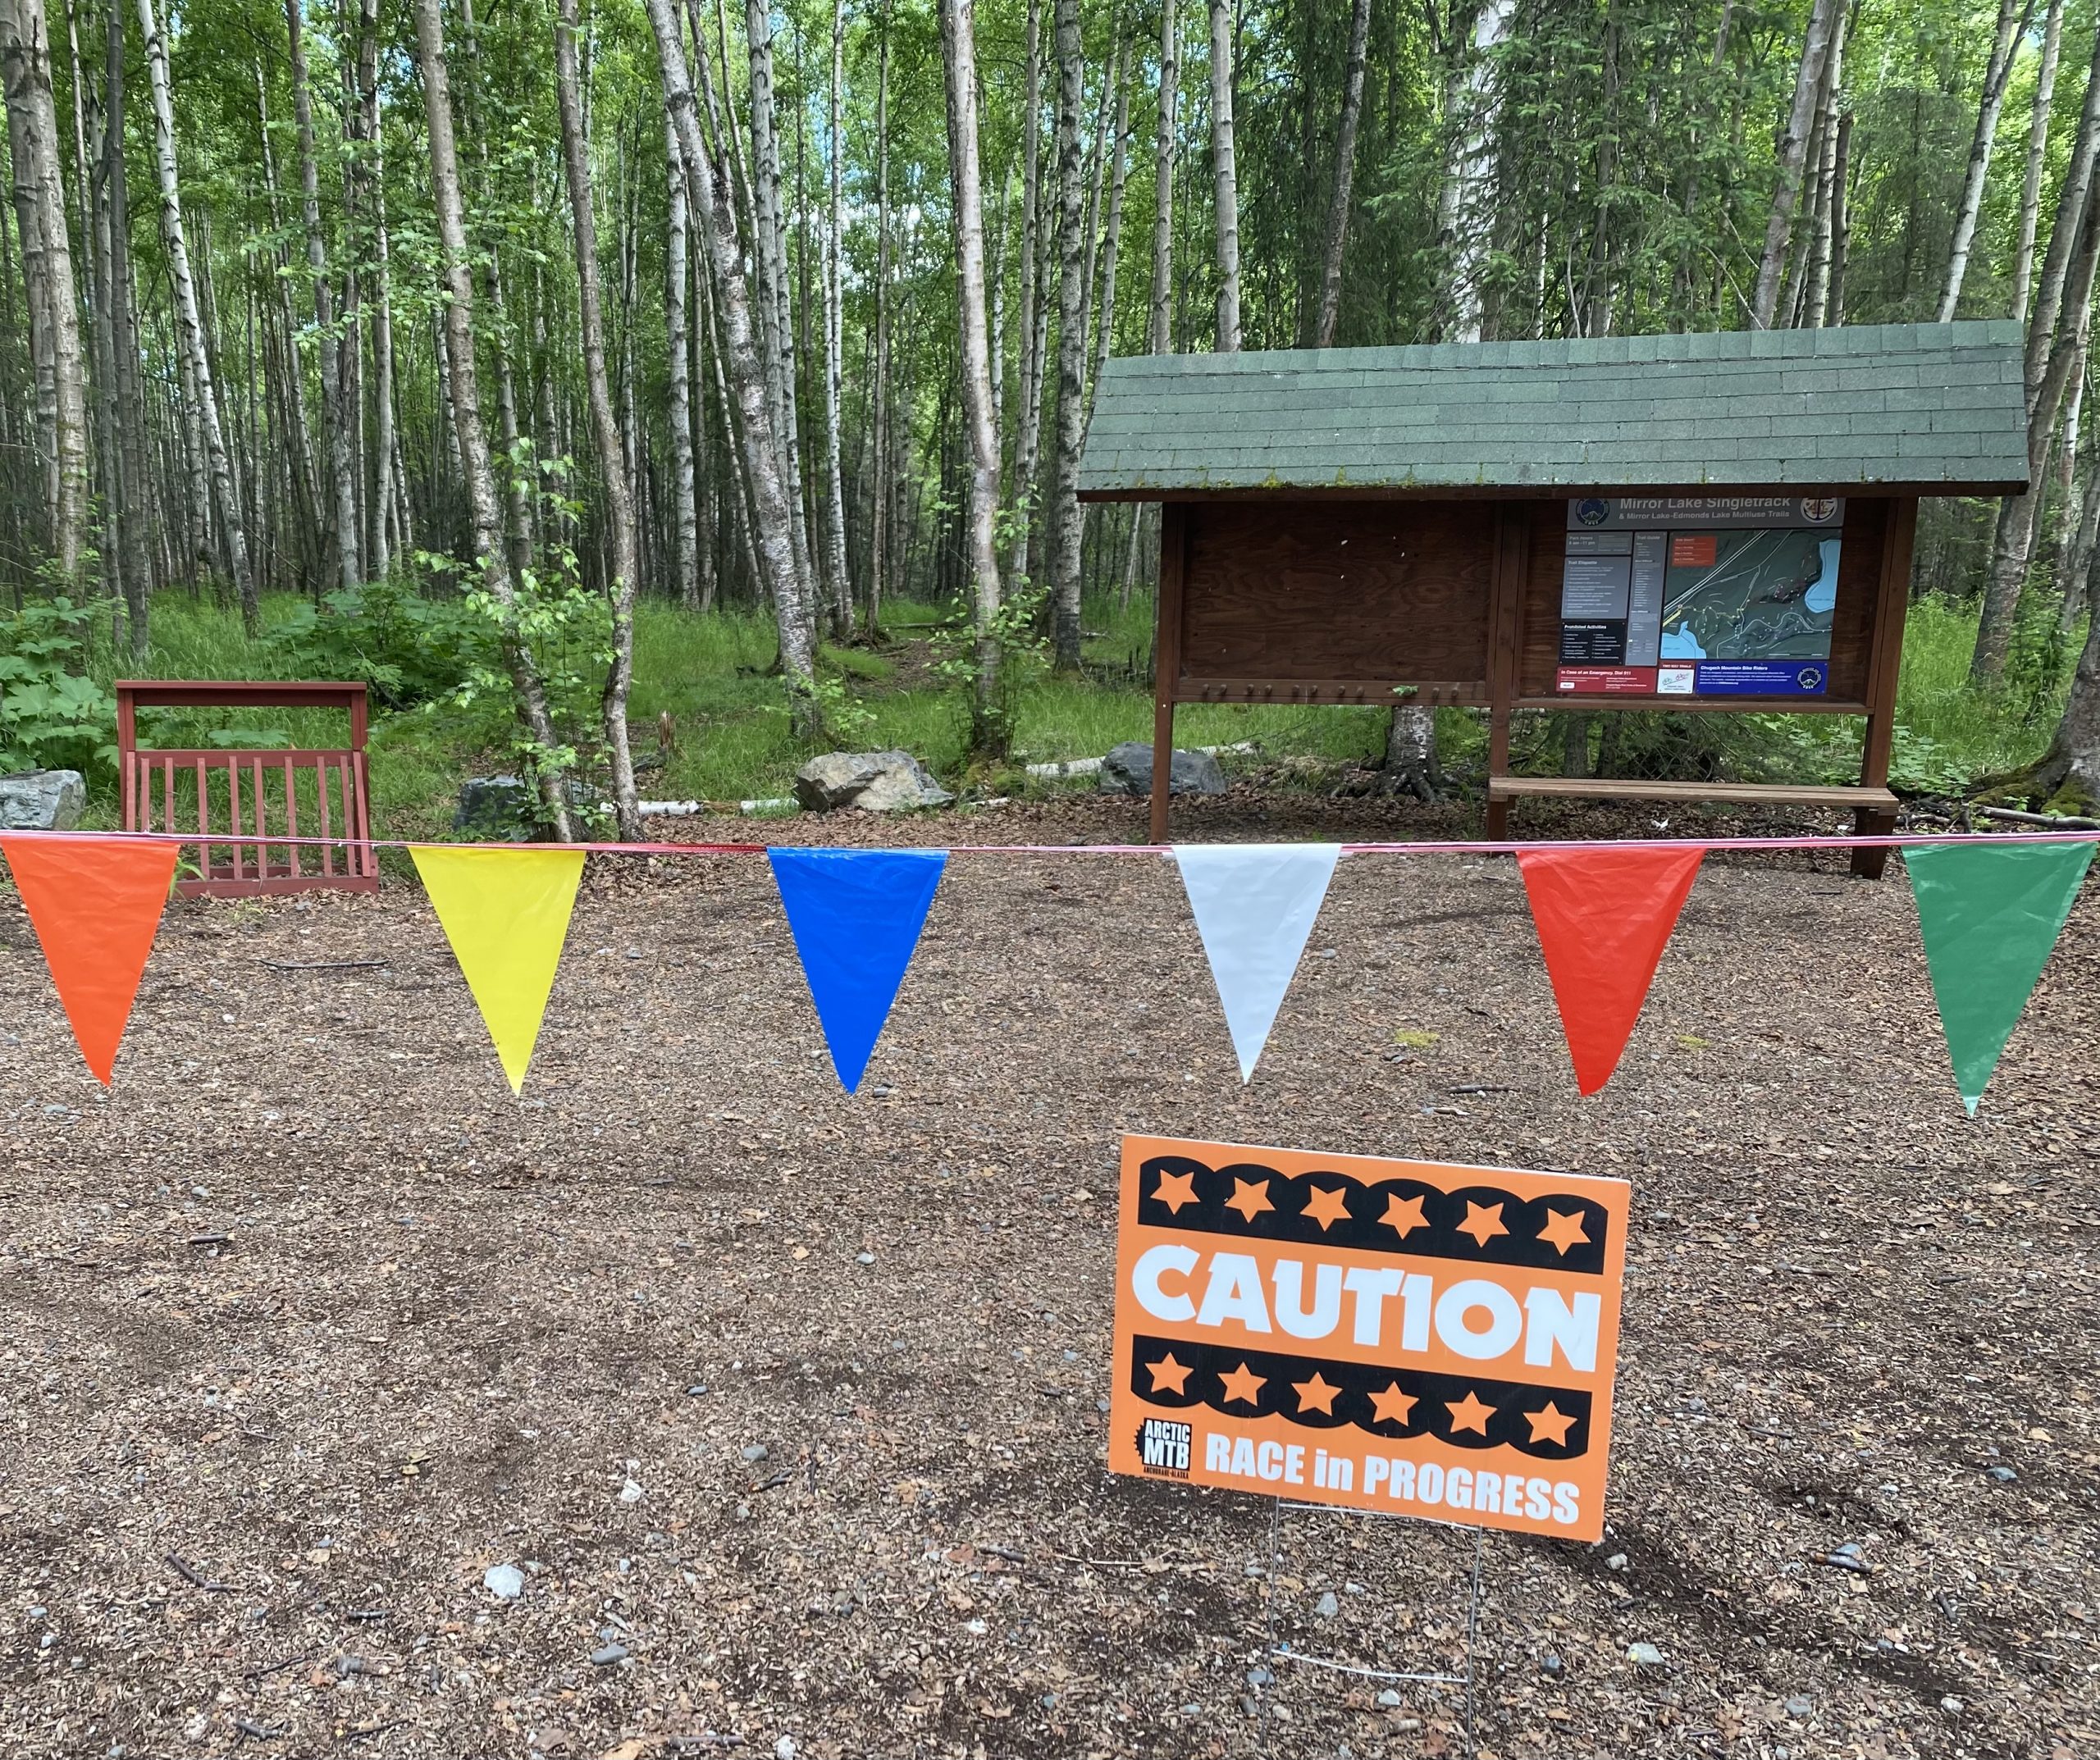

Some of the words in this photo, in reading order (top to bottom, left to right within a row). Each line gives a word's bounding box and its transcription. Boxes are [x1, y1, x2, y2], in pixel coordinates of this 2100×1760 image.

[1620, 498, 1663, 508] Mirror
[1668, 498, 1702, 508] Lake
[1706, 497, 1791, 510] Singletrack
[1131, 1243, 1602, 1373] CAUTION
[1145, 1419, 1190, 1443] ARCTIC
[1144, 1437, 1189, 1470] MTB
[1206, 1432, 1306, 1485] RACE
[1313, 1448, 1354, 1492] in
[1363, 1455, 1580, 1525] PROGRESS
